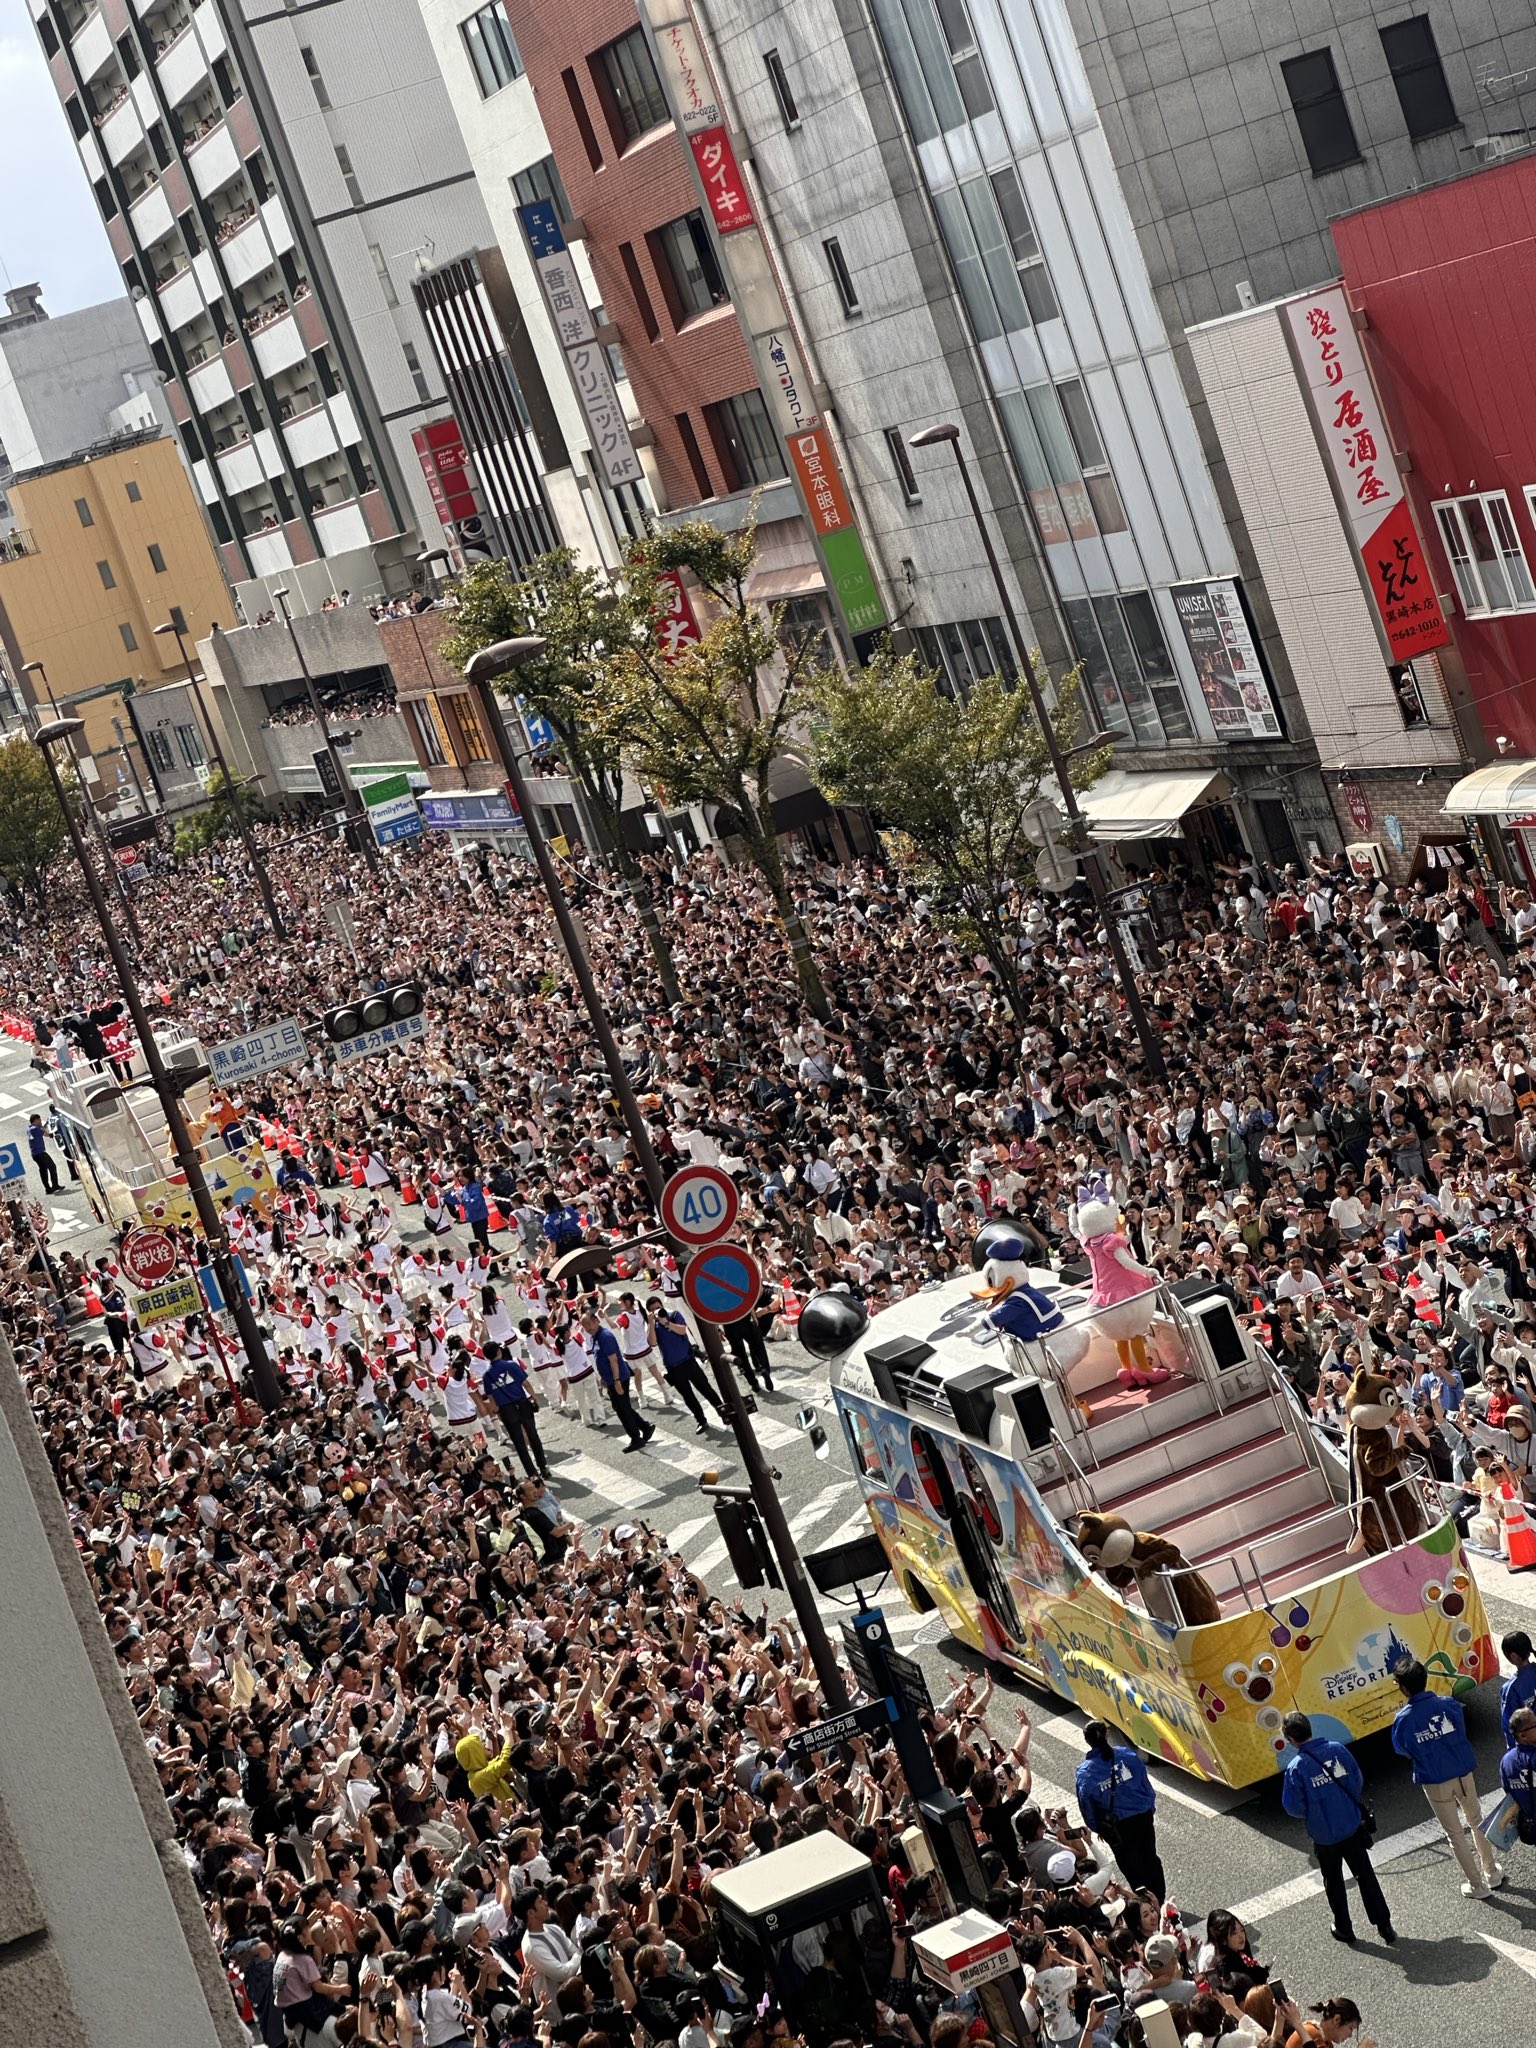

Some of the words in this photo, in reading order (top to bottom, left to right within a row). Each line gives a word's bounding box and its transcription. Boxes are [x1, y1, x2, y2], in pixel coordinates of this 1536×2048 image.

[707, 113, 719, 124] 5F
[692, 135, 703, 145] 4F
[702, 141, 740, 213] ダイキ
[769, 335, 805, 429] 八幡コンタクト
[573, 351, 618, 453] クリニック
[806, 416, 818, 427] 3F
[611, 457, 633, 478] 4F
[805, 456, 841, 528] 宮本眼科
[1177, 595, 1211, 613] UNISEX
[1385, 597, 1434, 625] 黒崎本店
[1399, 618, 1440, 640] 642-1010
[371, 800, 414, 819] FamilyMart
[382, 829, 395, 842] 酒
[397, 821, 420, 836] たばこ
[213, 1025, 299, 1070] 黒崎四丁目
[339, 1017, 424, 1059] 歩車分離信号
[217, 1059, 258, 1082] Kurosaki
[260, 1044, 301, 1066] 4-chome
[683, 1185, 722, 1224] 40
[132, 1244, 172, 1271] 消火栓
[137, 1282, 194, 1315] 原田歯科
[1078, 1632, 1113, 1663] TOKYO
[1327, 1668, 1386, 1700] RESORT
[1340, 1667, 1356, 1676] TOKYO
[802, 1715, 857, 1746] 商店街方面
[806, 1745, 816, 1753] For
[816, 1733, 844, 1749] Shopping
[844, 1727, 862, 1738] Street
[959, 1952, 1009, 1983] 黒崎四丁目
[963, 1974, 989, 1988] KUROSAKI
